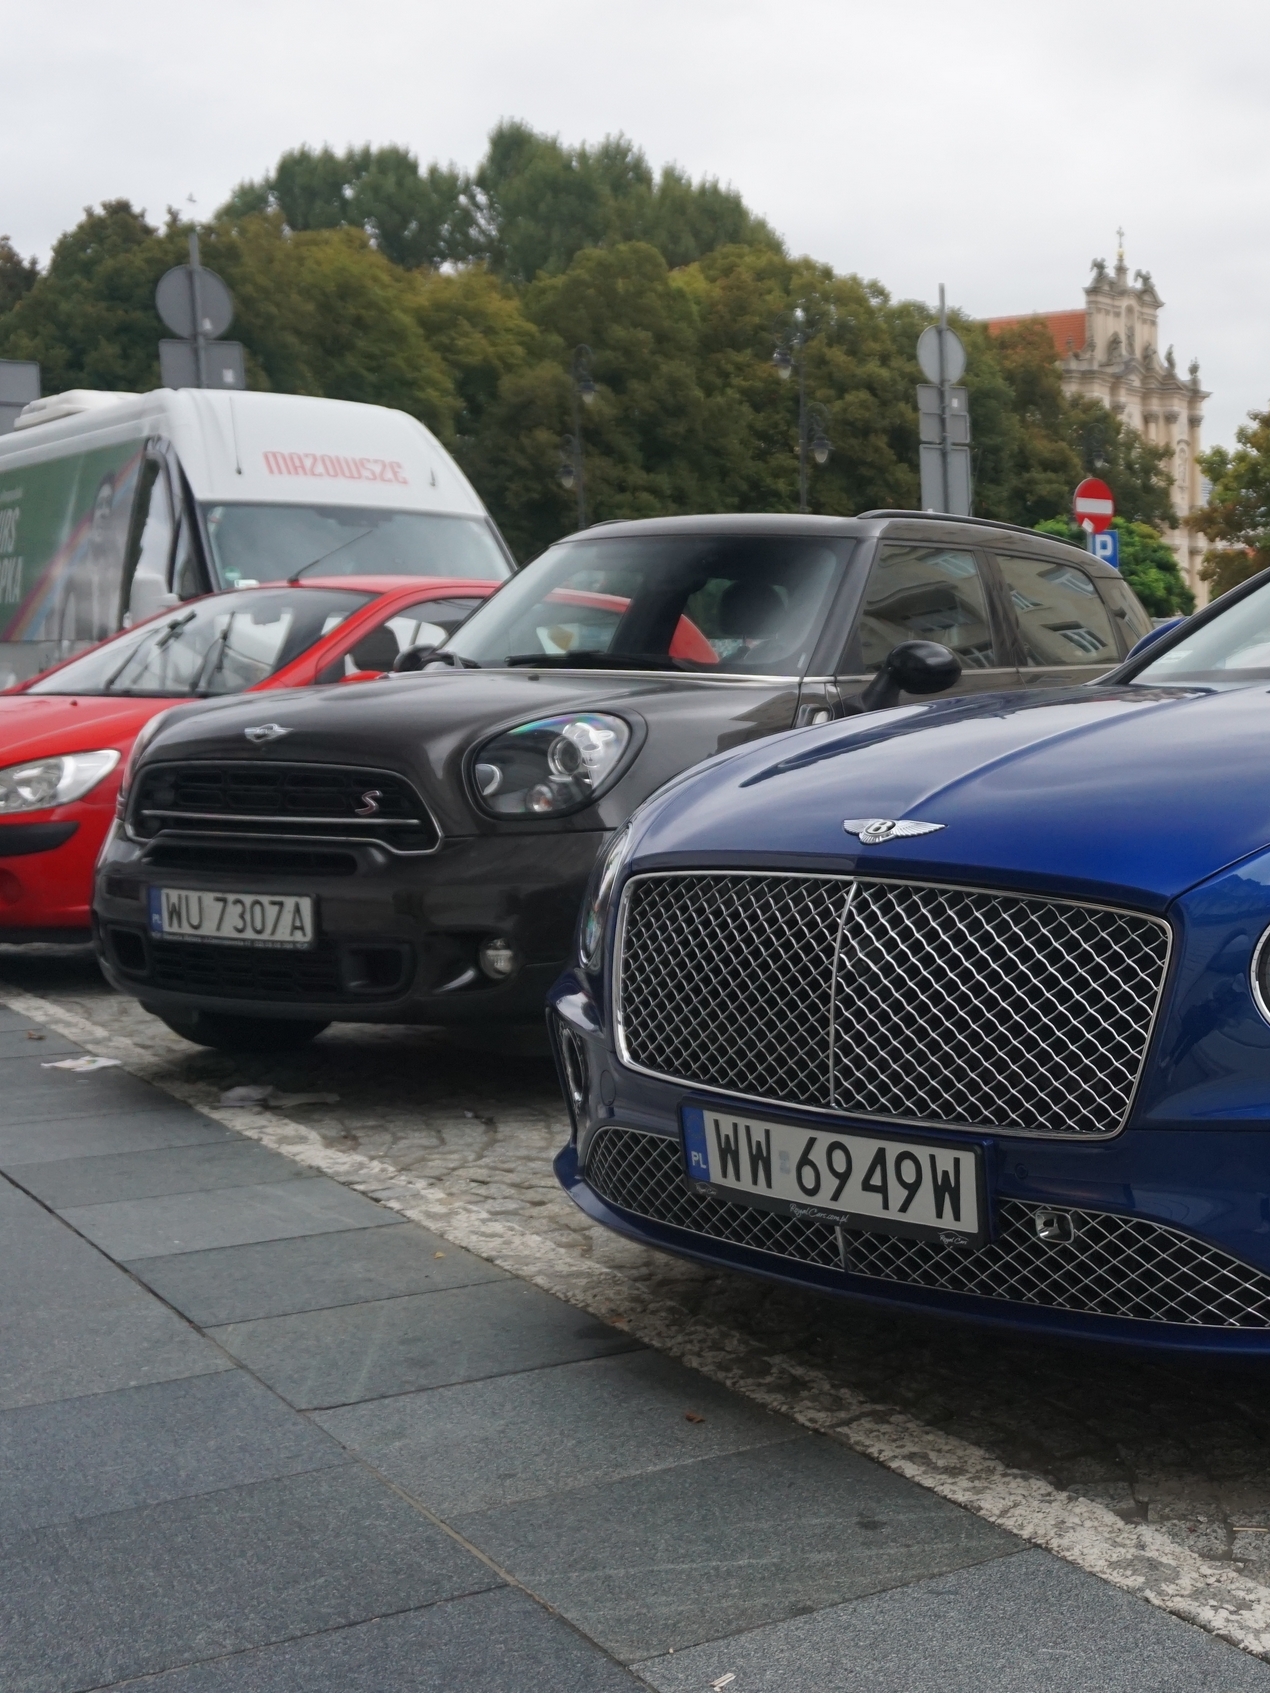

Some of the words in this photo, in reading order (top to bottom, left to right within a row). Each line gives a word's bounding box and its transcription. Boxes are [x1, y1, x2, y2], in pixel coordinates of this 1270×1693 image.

[263, 451, 408, 484] MAZOWSZE
[1095, 534, 1113, 559] P
[354, 790, 380, 815] S
[165, 893, 203, 930] WU
[213, 896, 307, 937] 7307A
[691, 1151, 707, 1169] PL
[712, 1118, 773, 1189] WW
[795, 1136, 961, 1222] 6949W
